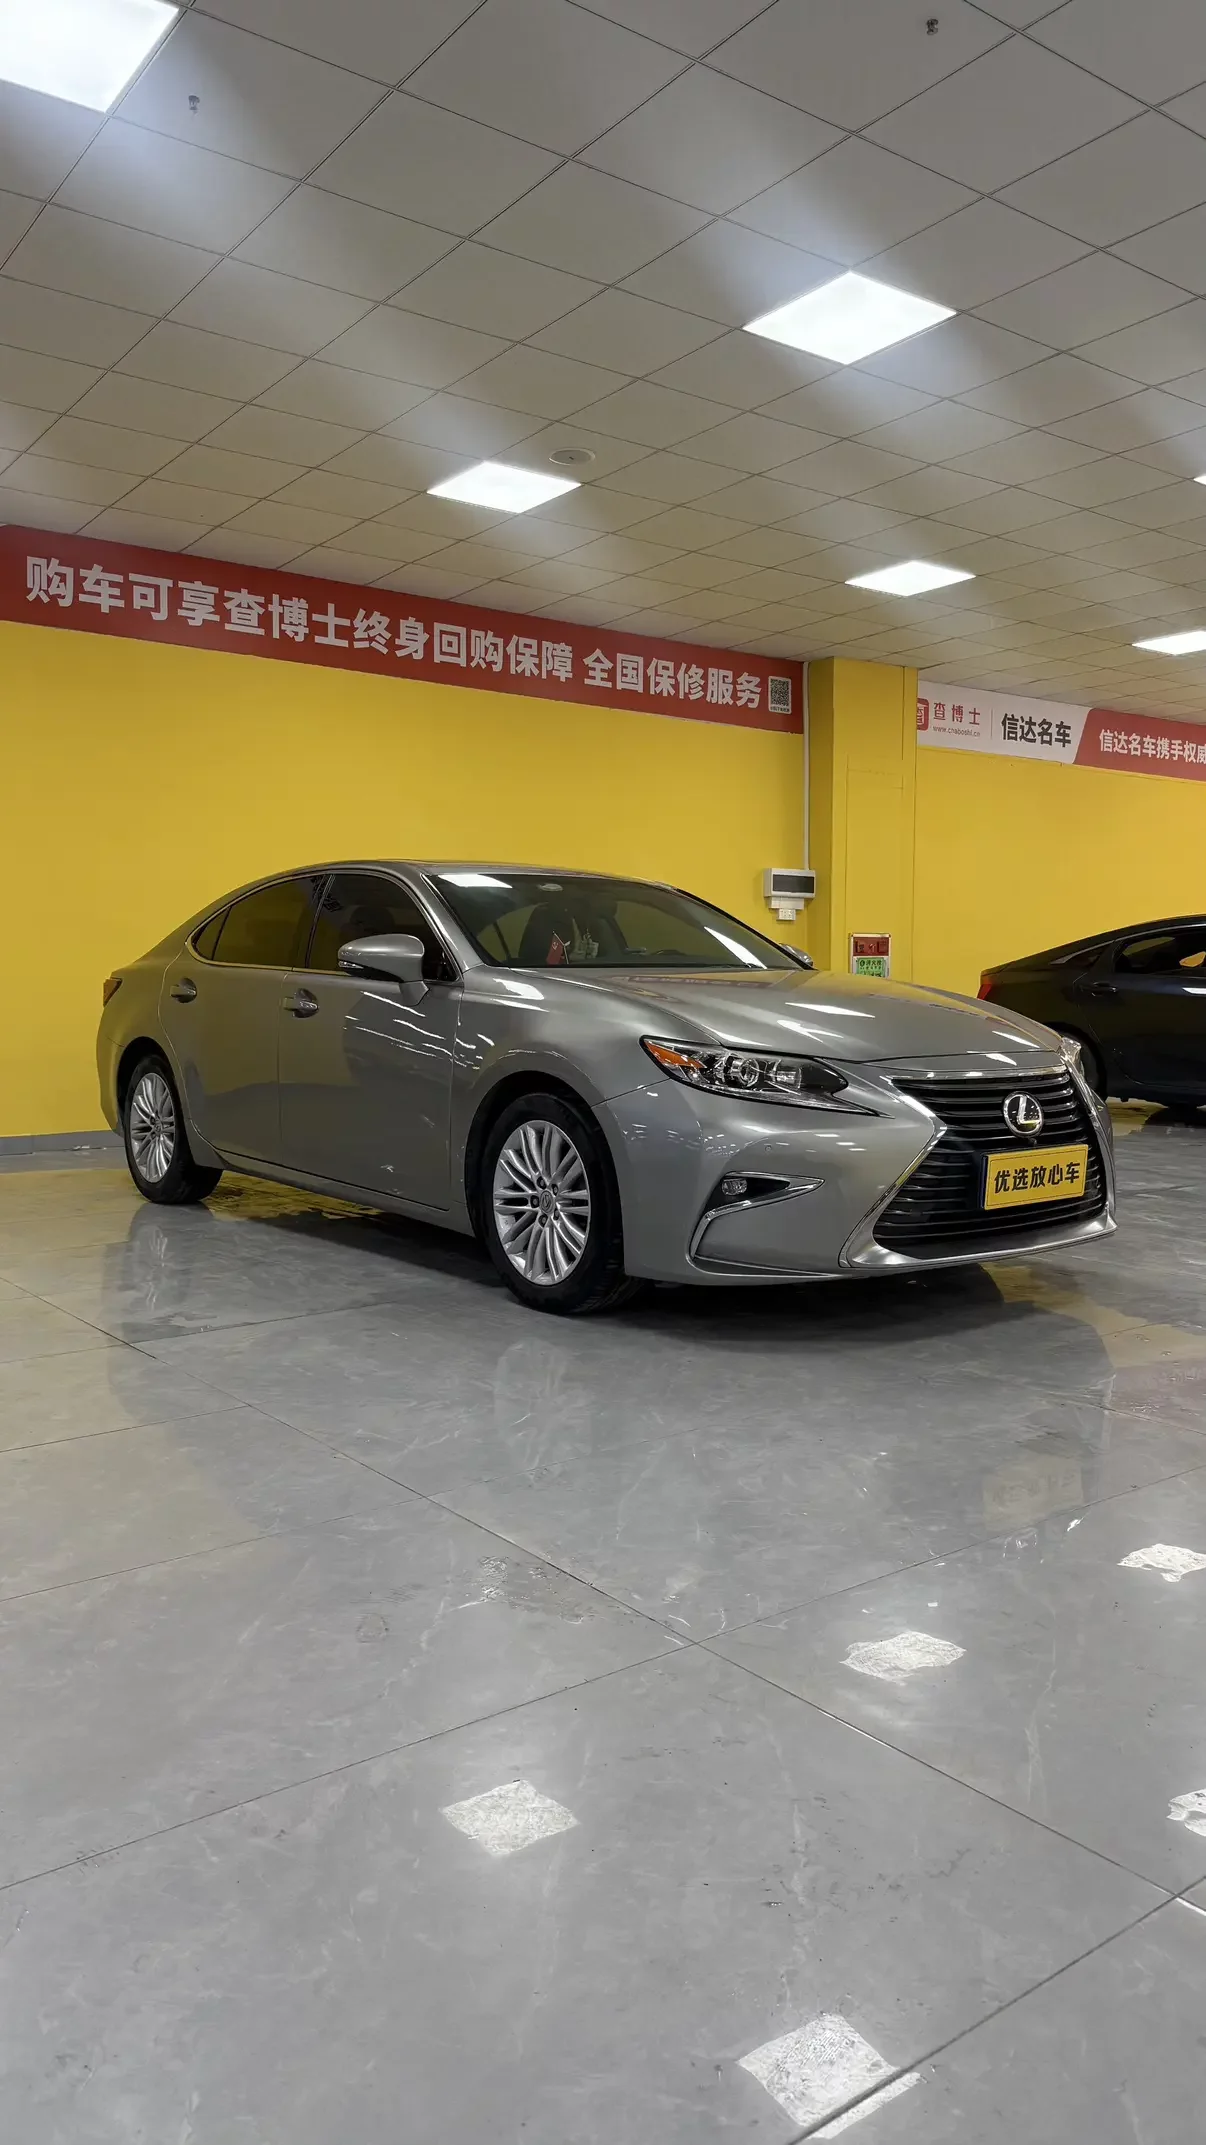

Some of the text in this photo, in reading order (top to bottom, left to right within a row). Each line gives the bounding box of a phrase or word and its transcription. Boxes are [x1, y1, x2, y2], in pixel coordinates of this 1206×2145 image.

[26, 555, 762, 709] 购车可享查博士终身回购保障 全国保修服务
[933, 701, 981, 726] 查博士
[1001, 713, 1072, 748] 信达名车
[994, 1162, 1081, 1194] 优选放心车
